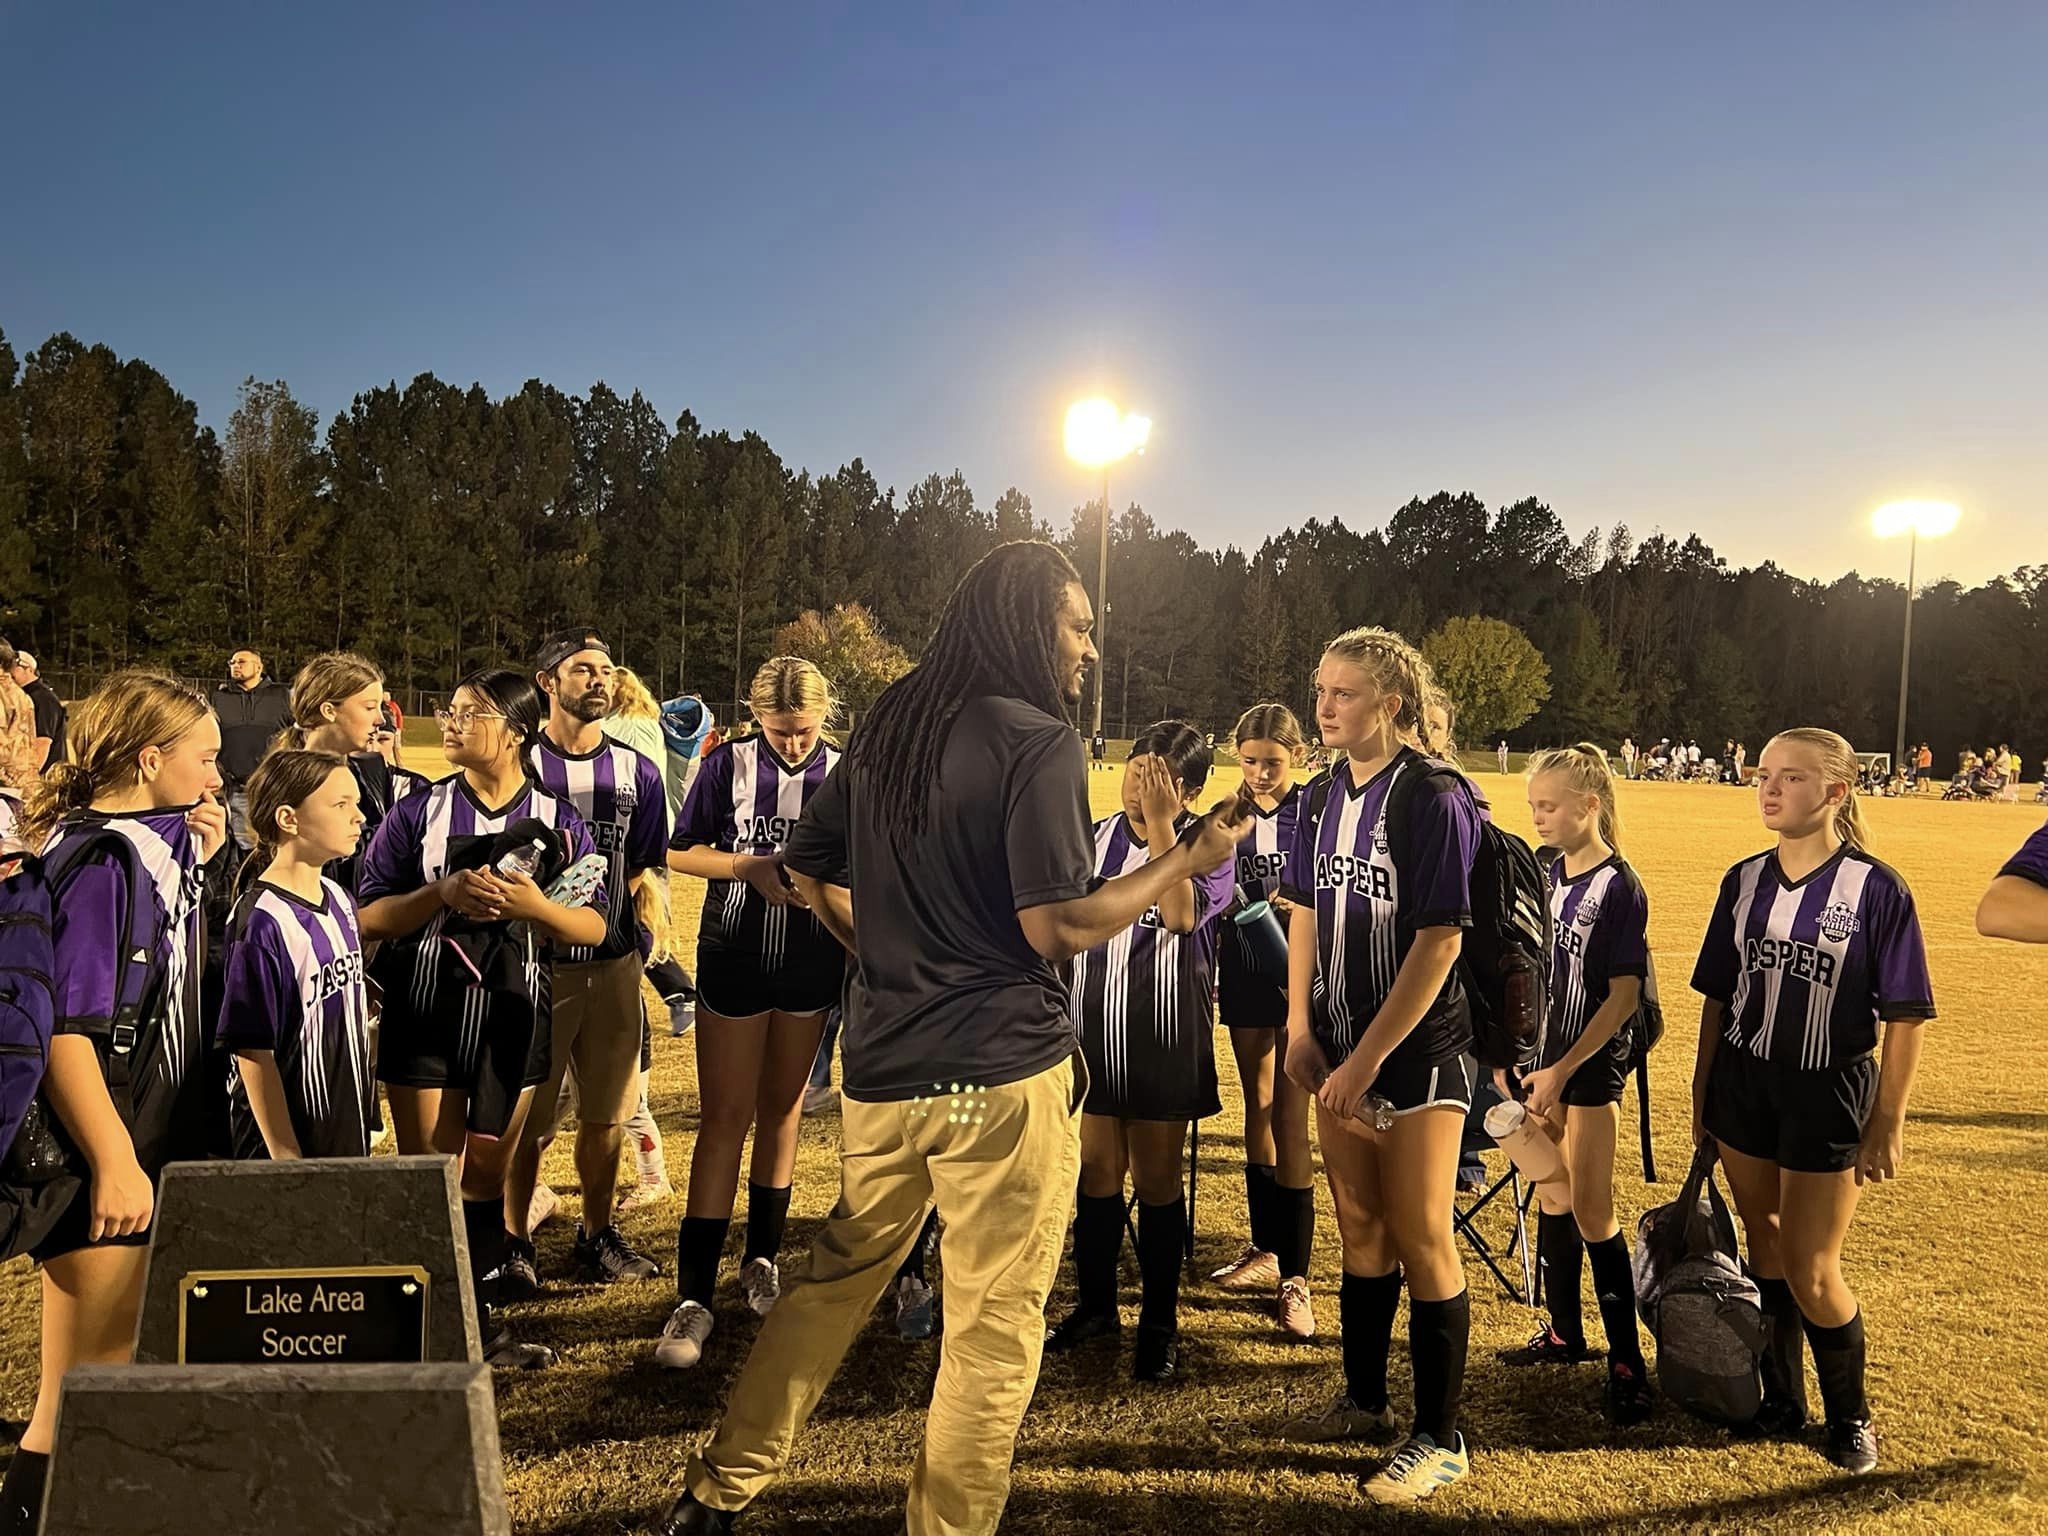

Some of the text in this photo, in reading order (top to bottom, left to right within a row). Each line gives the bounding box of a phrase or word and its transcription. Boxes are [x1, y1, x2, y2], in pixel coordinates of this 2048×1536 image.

[245, 1283, 366, 1315] Lake Area
[261, 1327, 348, 1358] Soccer
